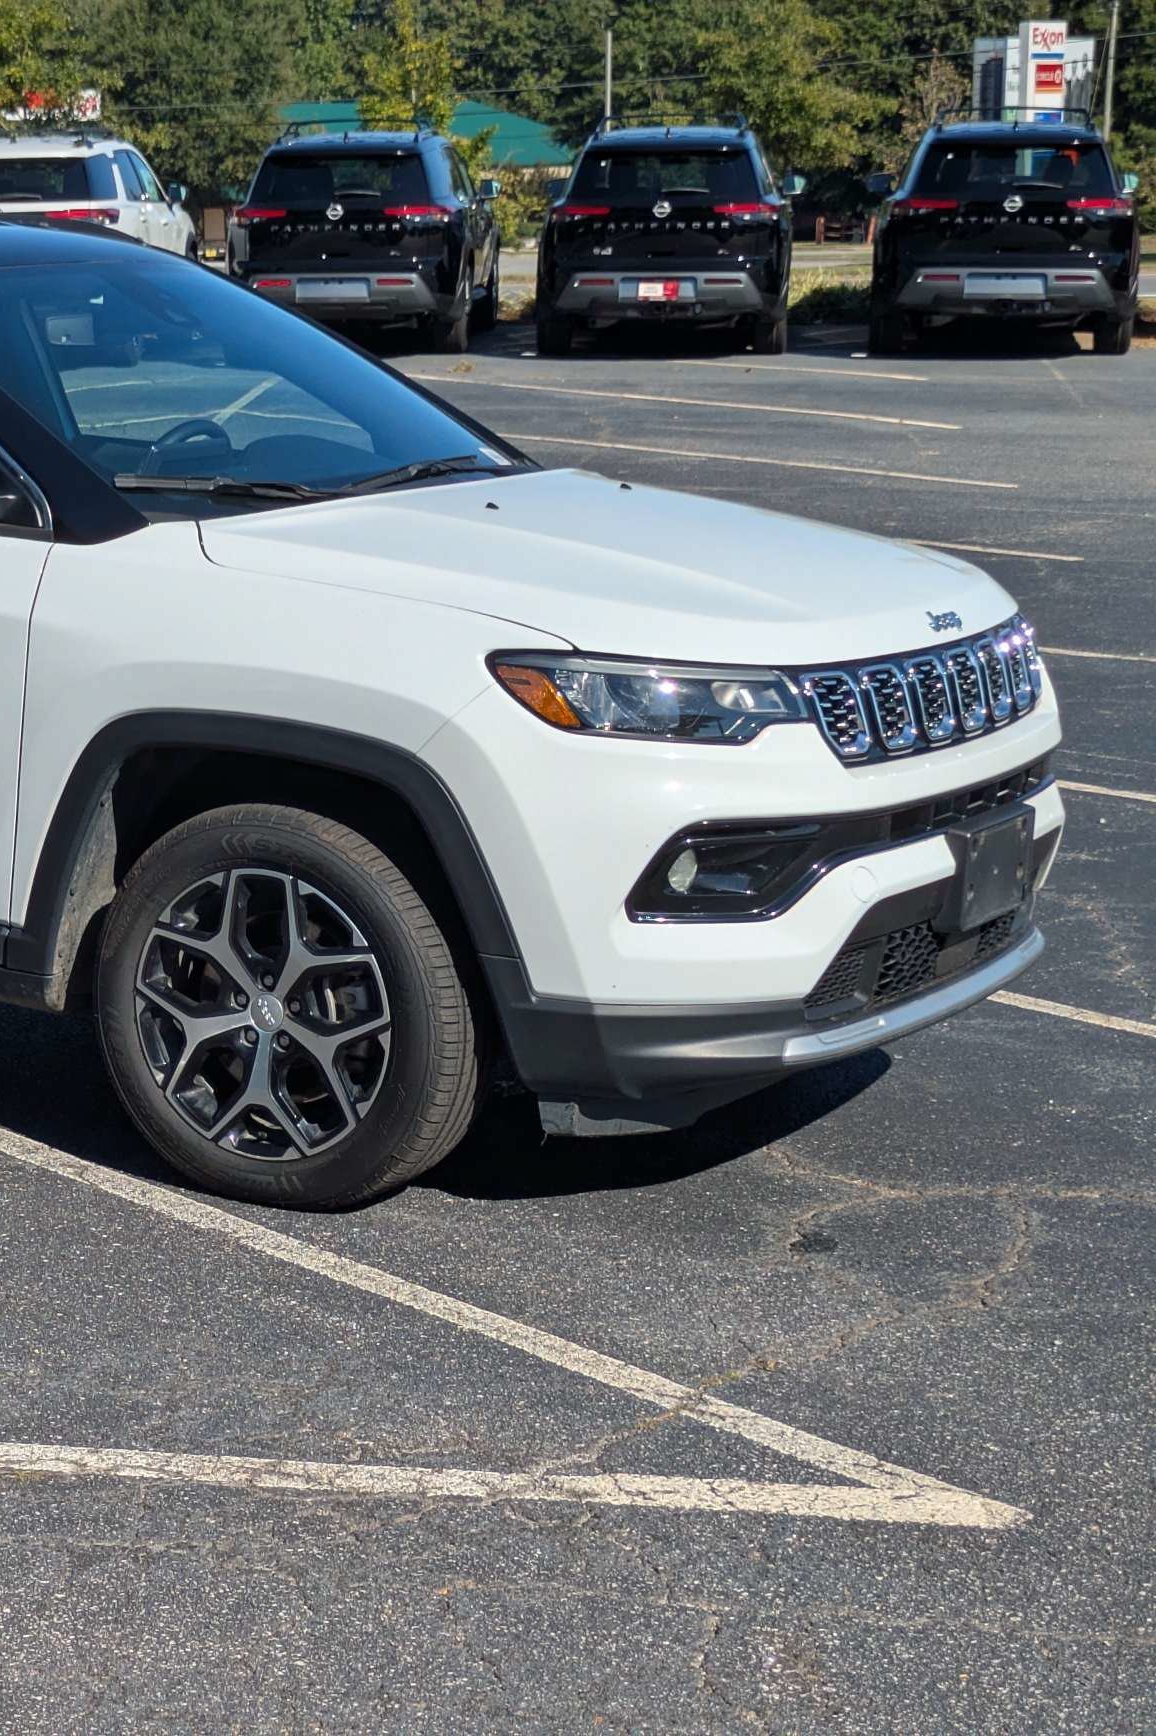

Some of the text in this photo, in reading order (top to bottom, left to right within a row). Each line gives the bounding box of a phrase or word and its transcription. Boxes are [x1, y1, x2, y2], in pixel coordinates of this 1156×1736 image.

[1032, 28, 1064, 51] Exxon
[940, 216, 1084, 224] PATHFINDER
[270, 223, 400, 232] PATHFINDER
[593, 221, 730, 230] PATHFINDER
